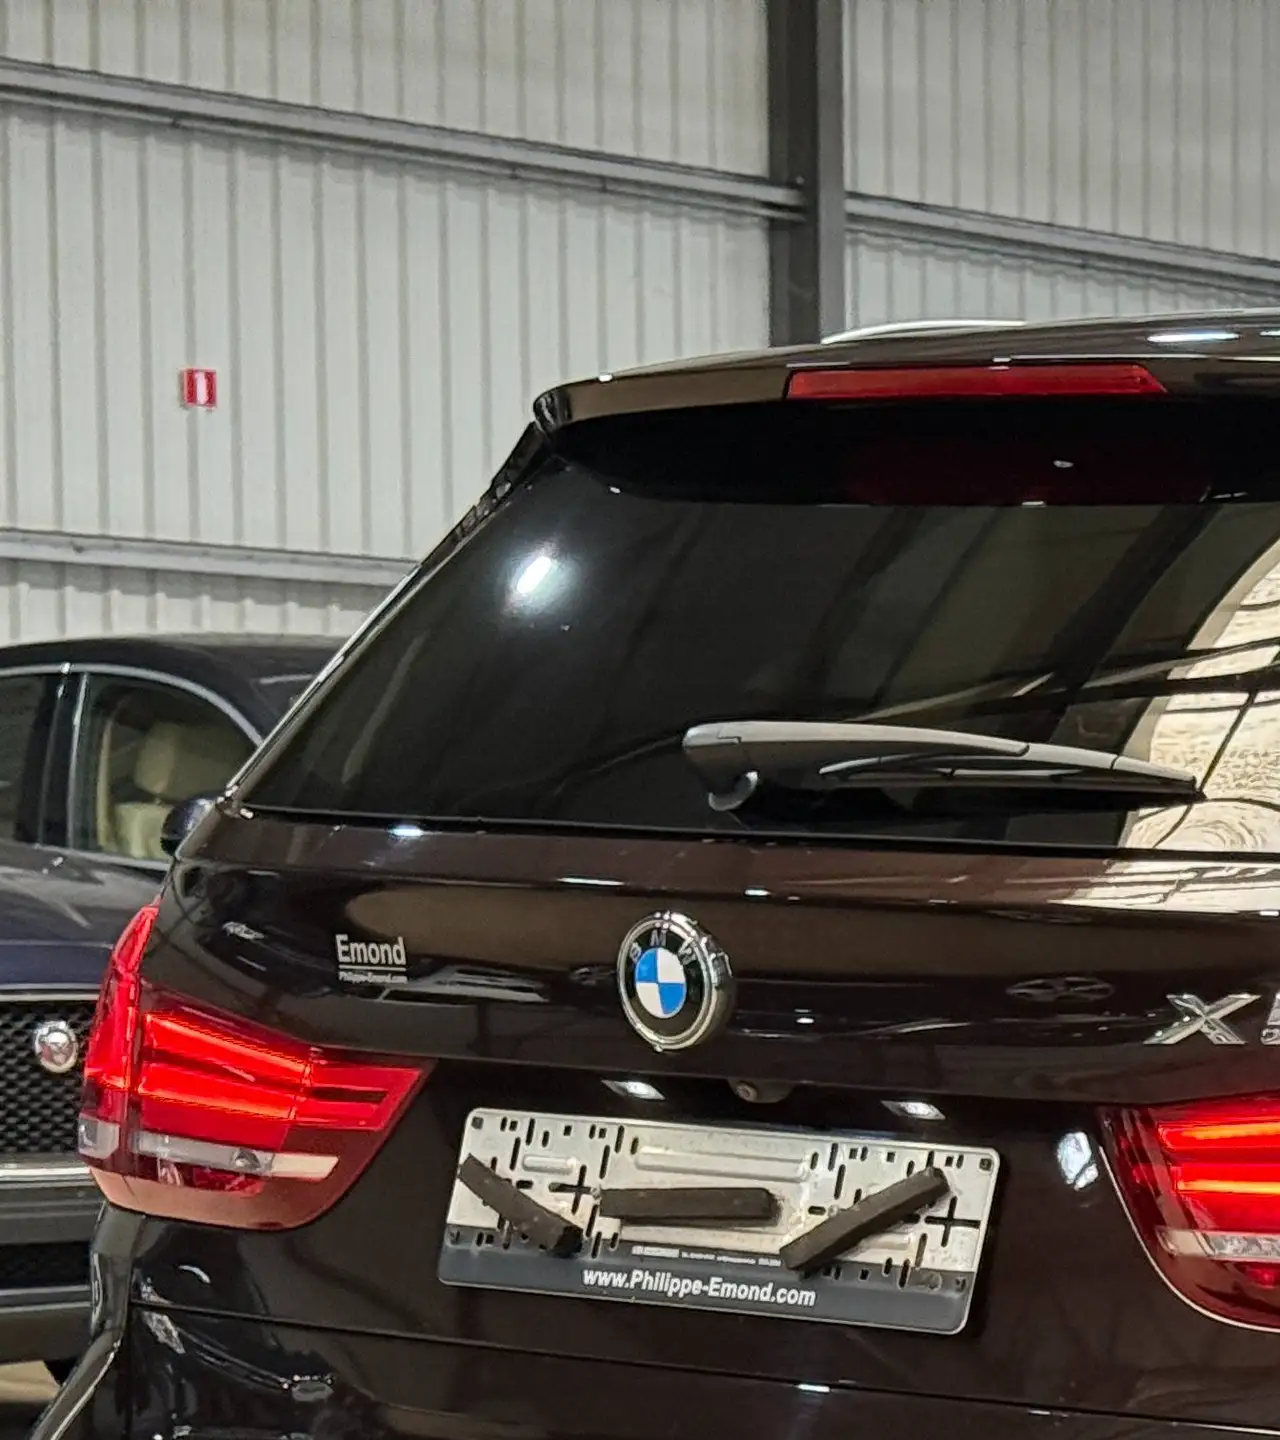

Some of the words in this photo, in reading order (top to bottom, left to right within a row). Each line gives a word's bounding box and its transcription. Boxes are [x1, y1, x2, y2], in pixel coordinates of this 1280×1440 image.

[335, 933, 407, 966] Emond
[629, 928, 698, 965] BMW
[583, 1268, 817, 1307] www.Philippe-Emond.com
